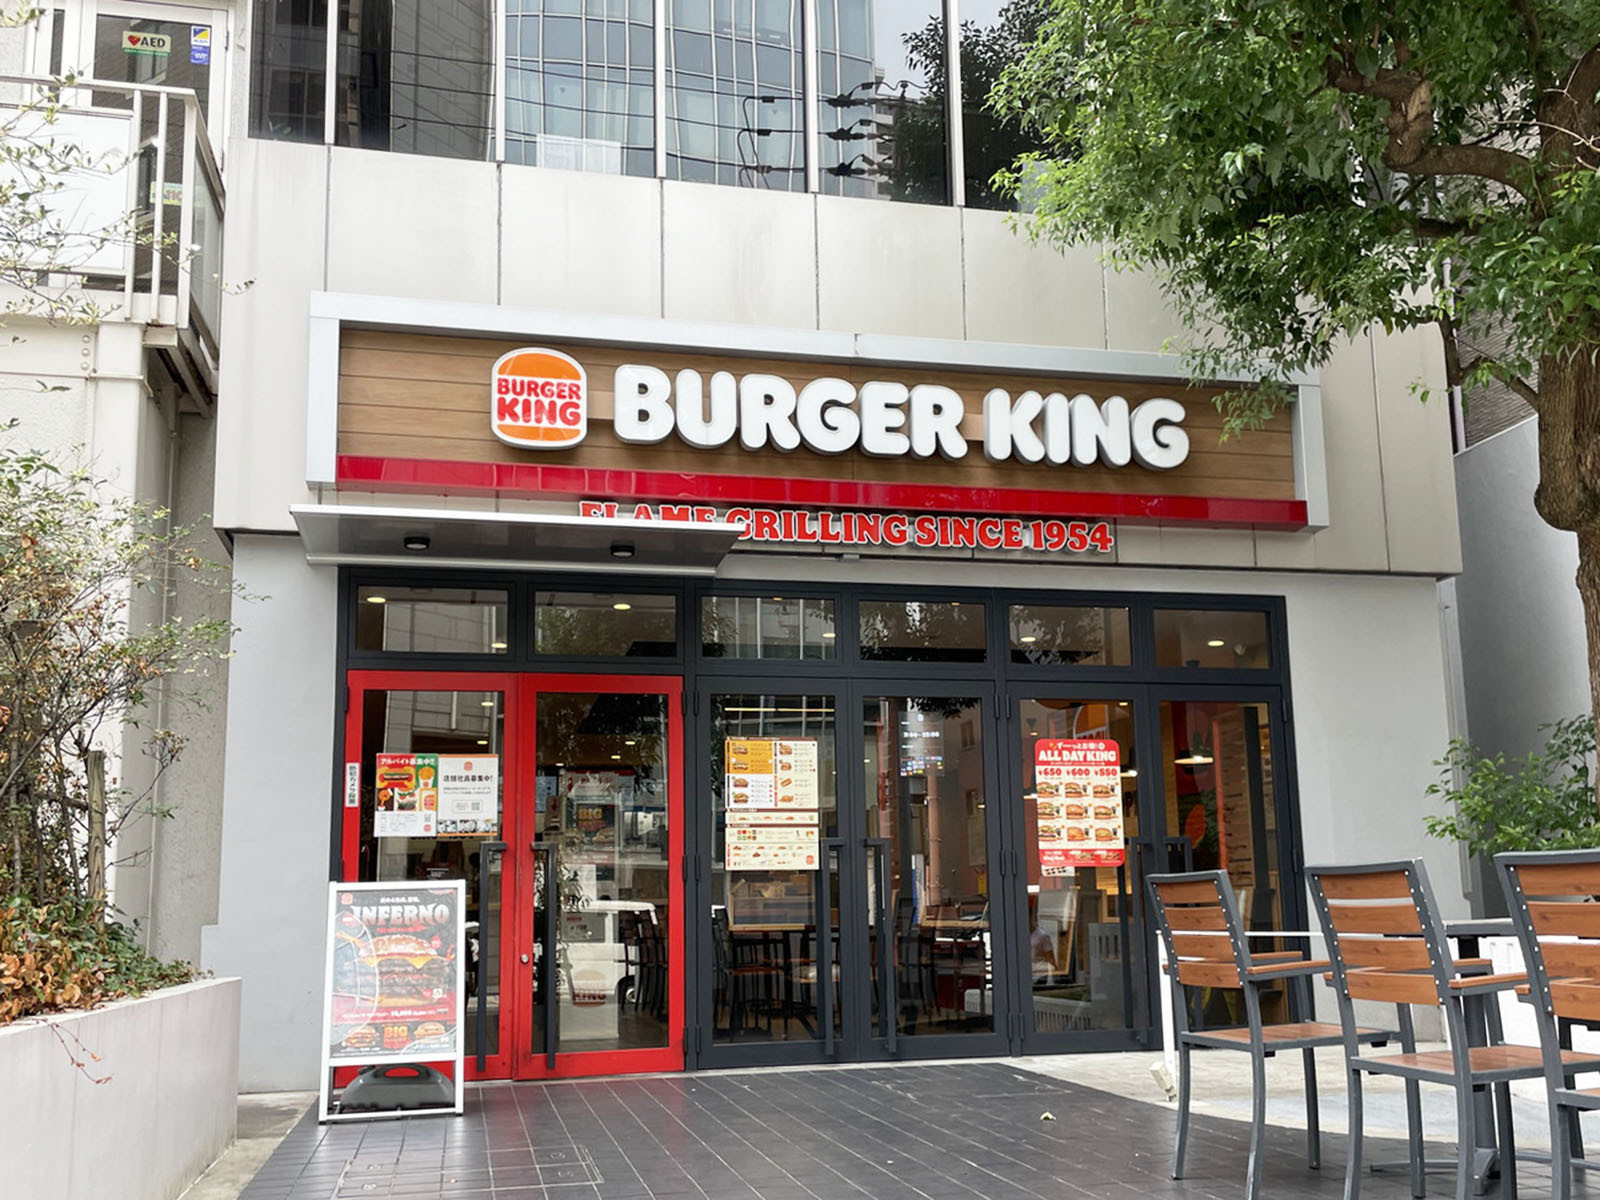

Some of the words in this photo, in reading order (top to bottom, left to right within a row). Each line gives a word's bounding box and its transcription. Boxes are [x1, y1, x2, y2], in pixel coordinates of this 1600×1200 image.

[140, 36, 166, 48] AED
[497, 377, 581, 400] BURGER
[497, 397, 581, 426] KING
[614, 364, 968, 460] BURGER
[983, 387, 1190, 469] KING
[724, 507, 908, 546] GRILLING
[915, 516, 1024, 549] SINCE
[1030, 520, 1114, 552] 1954
[1039, 750, 1061, 761] ALL
[1062, 750, 1086, 762] DAY
[1086, 751, 1117, 763] KING
[350, 902, 450, 928] INFERNO
[383, 1025, 409, 1038] BIG
